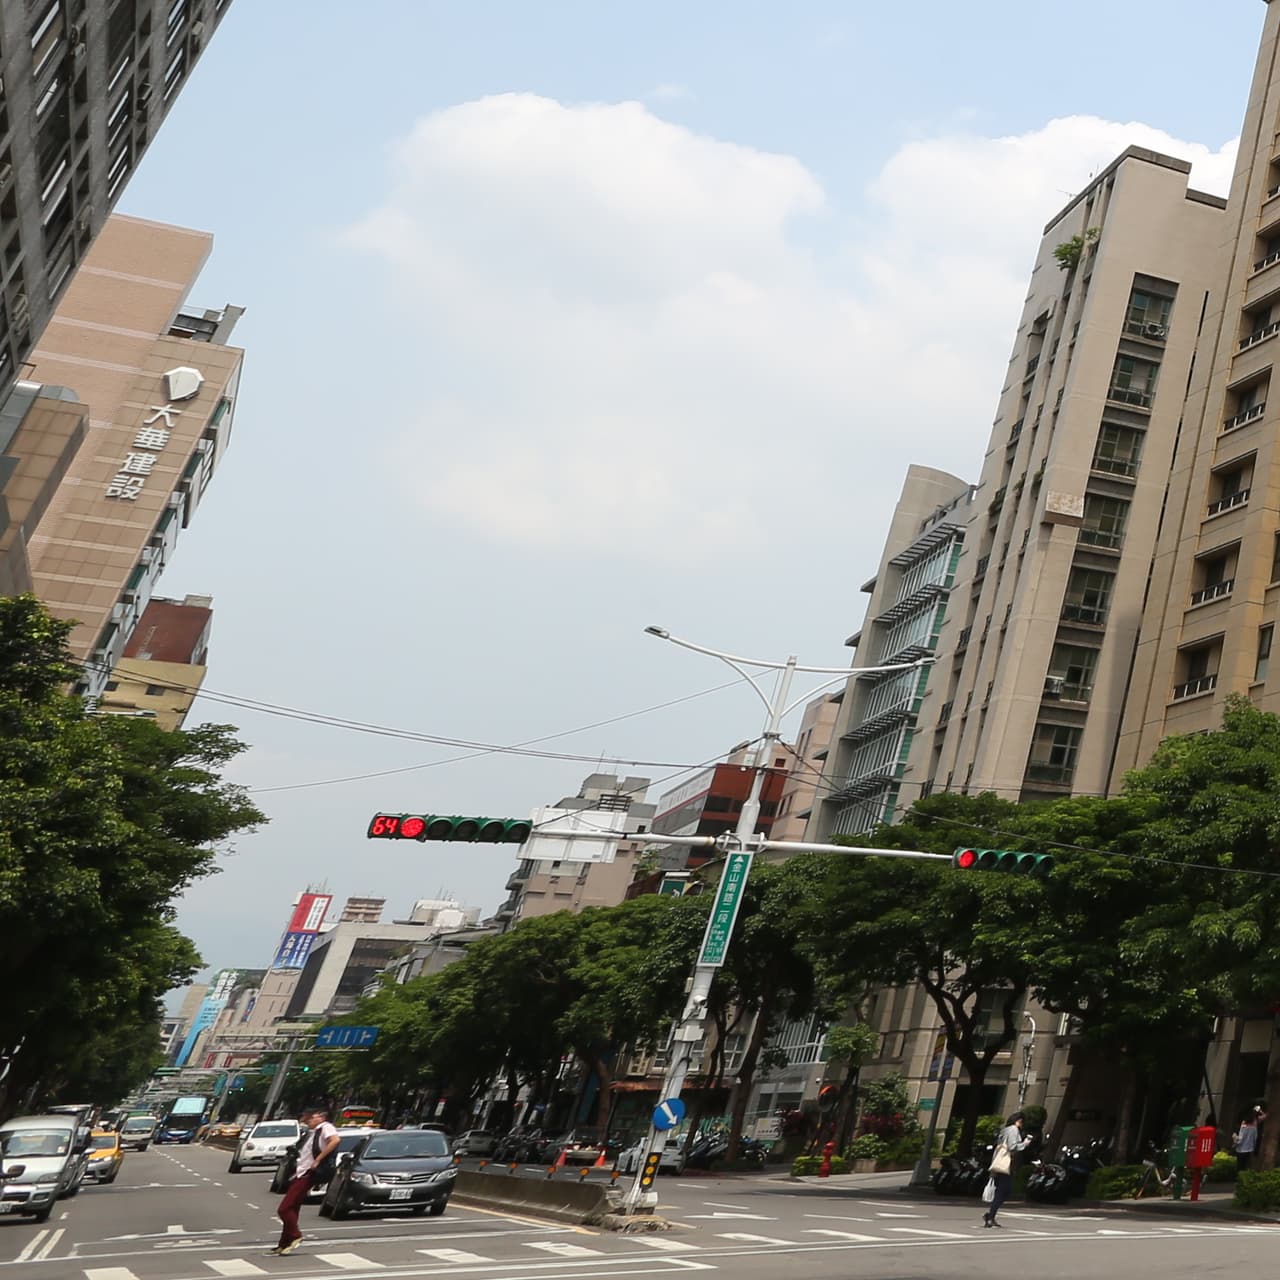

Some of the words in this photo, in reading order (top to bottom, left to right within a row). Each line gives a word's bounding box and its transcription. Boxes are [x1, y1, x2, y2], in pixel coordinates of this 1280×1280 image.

[105, 404, 182, 500] 大華建設
[372, 816, 398, 835] 64
[717, 862, 743, 923] 金山南路二段
